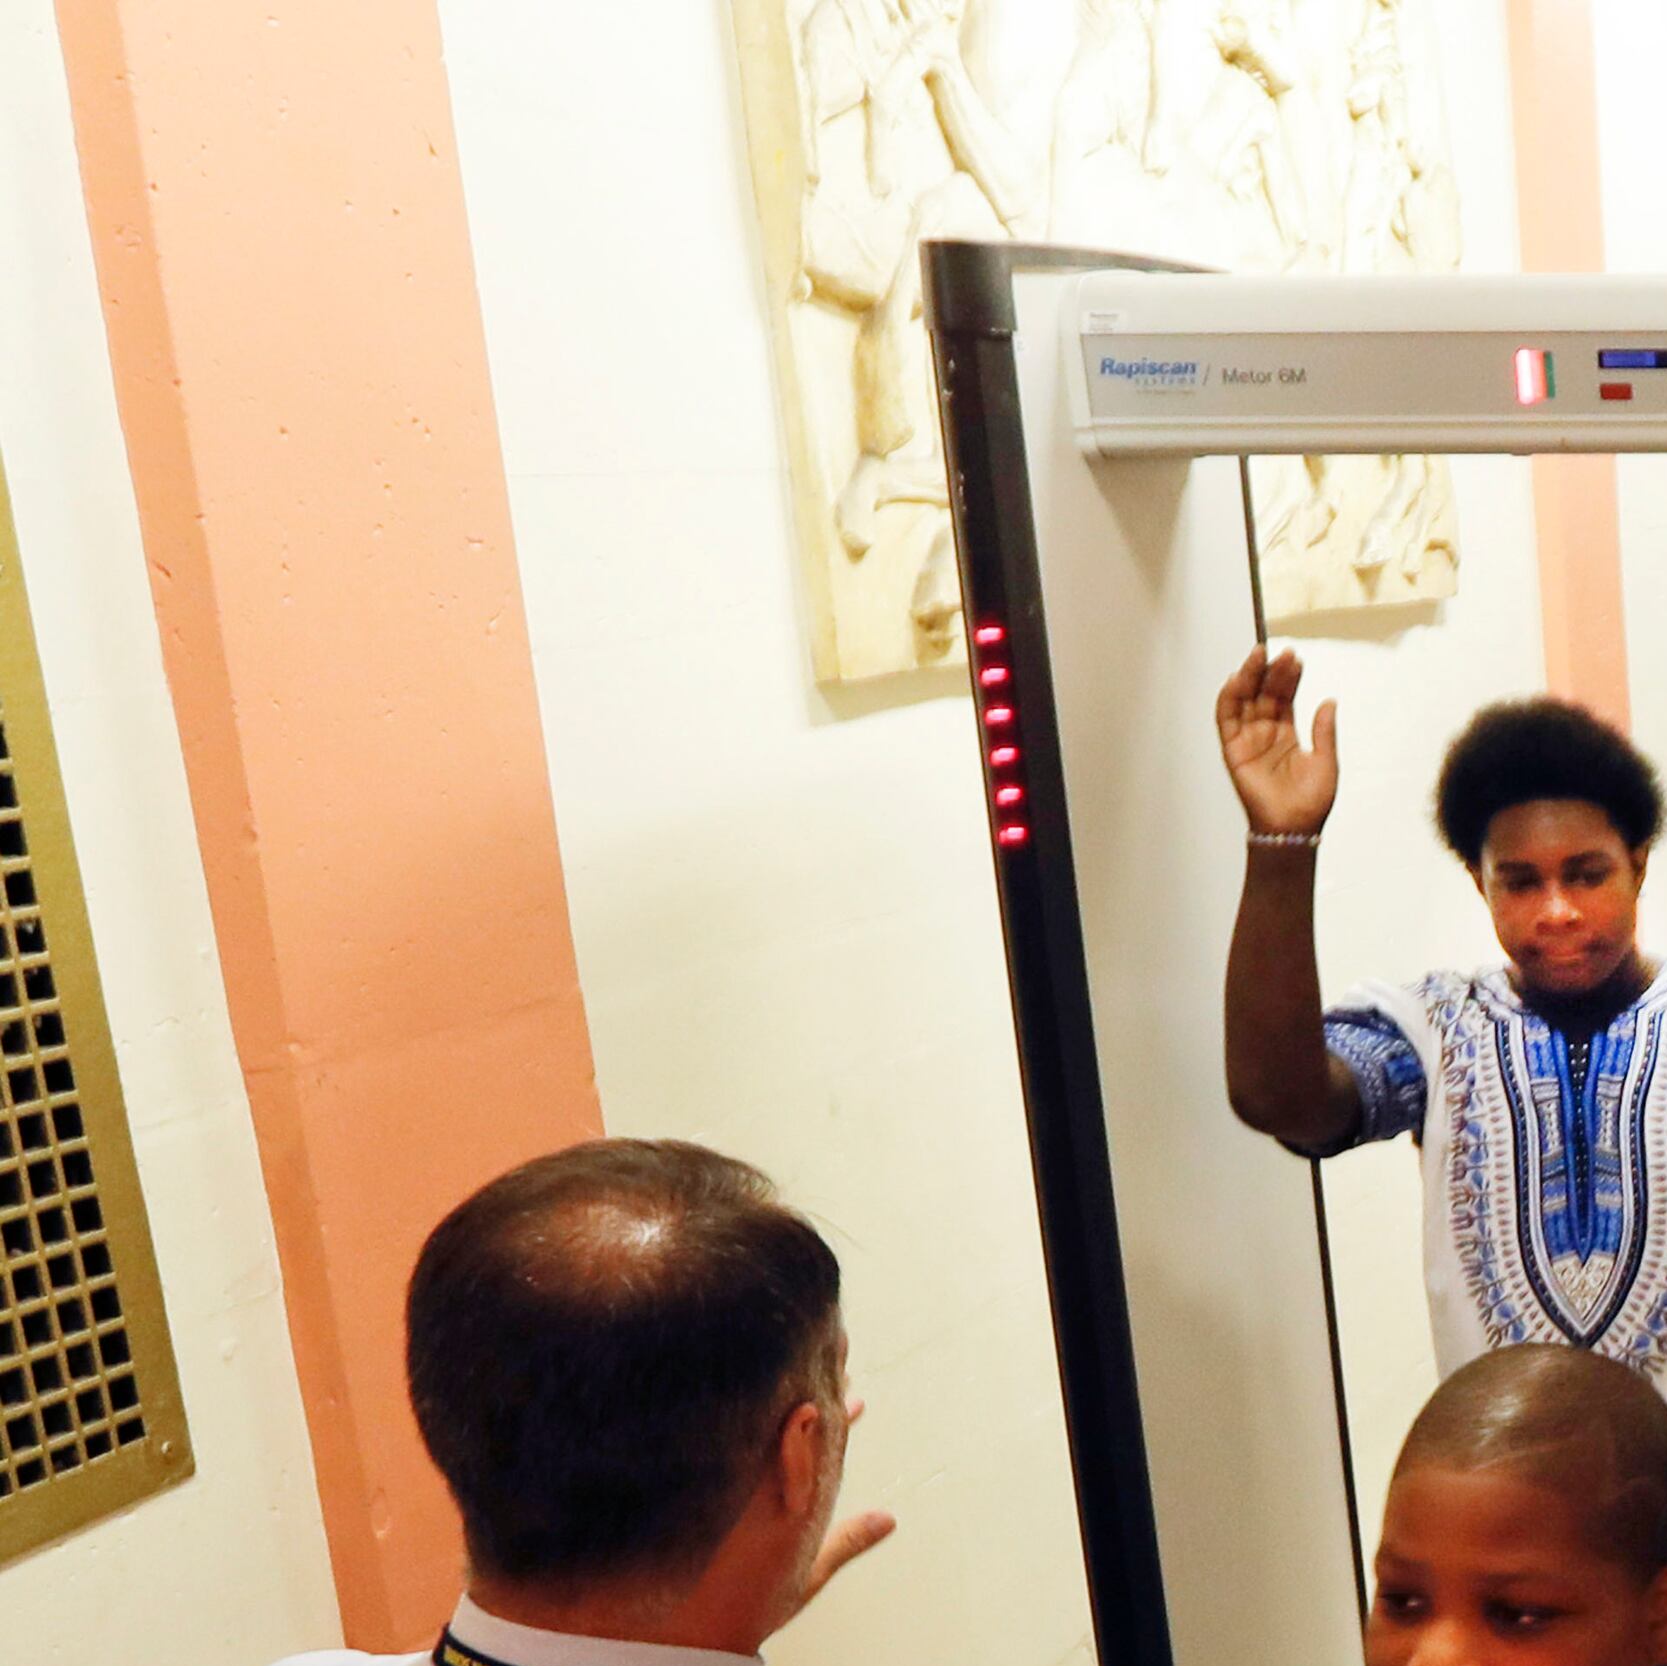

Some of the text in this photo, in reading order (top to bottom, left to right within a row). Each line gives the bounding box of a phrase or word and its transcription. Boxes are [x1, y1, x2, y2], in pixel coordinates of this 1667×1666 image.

[1099, 356, 1308, 385] Rapiscan Metor 6M
